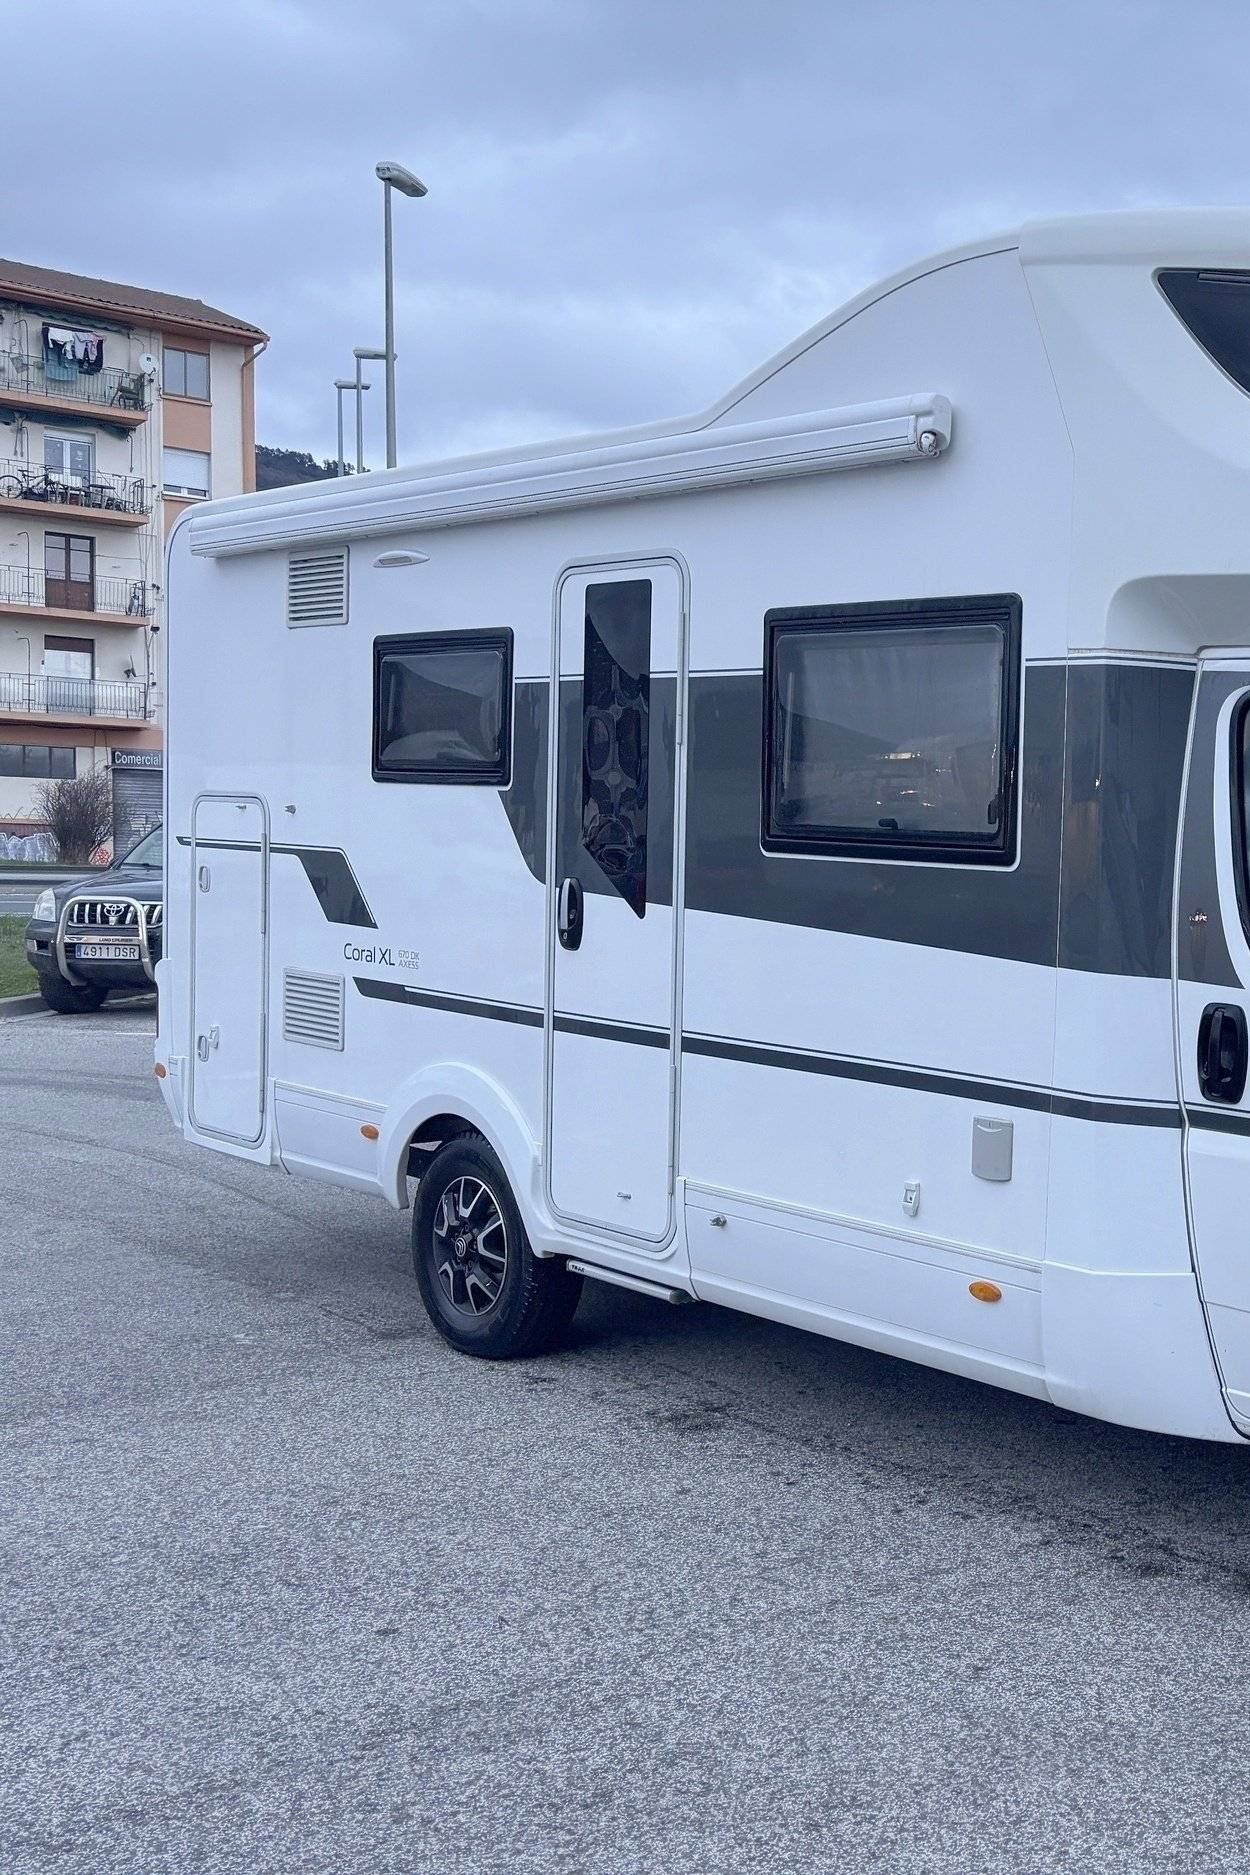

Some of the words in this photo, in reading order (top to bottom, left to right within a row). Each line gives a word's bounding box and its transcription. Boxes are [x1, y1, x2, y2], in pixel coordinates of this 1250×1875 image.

[114, 751, 162, 766] Comercial
[83, 946, 111, 958] 4911
[114, 947, 137, 958] DSR
[343, 943, 376, 963] Coral
[378, 947, 396, 966] XL
[398, 959, 419, 970] AXESS
